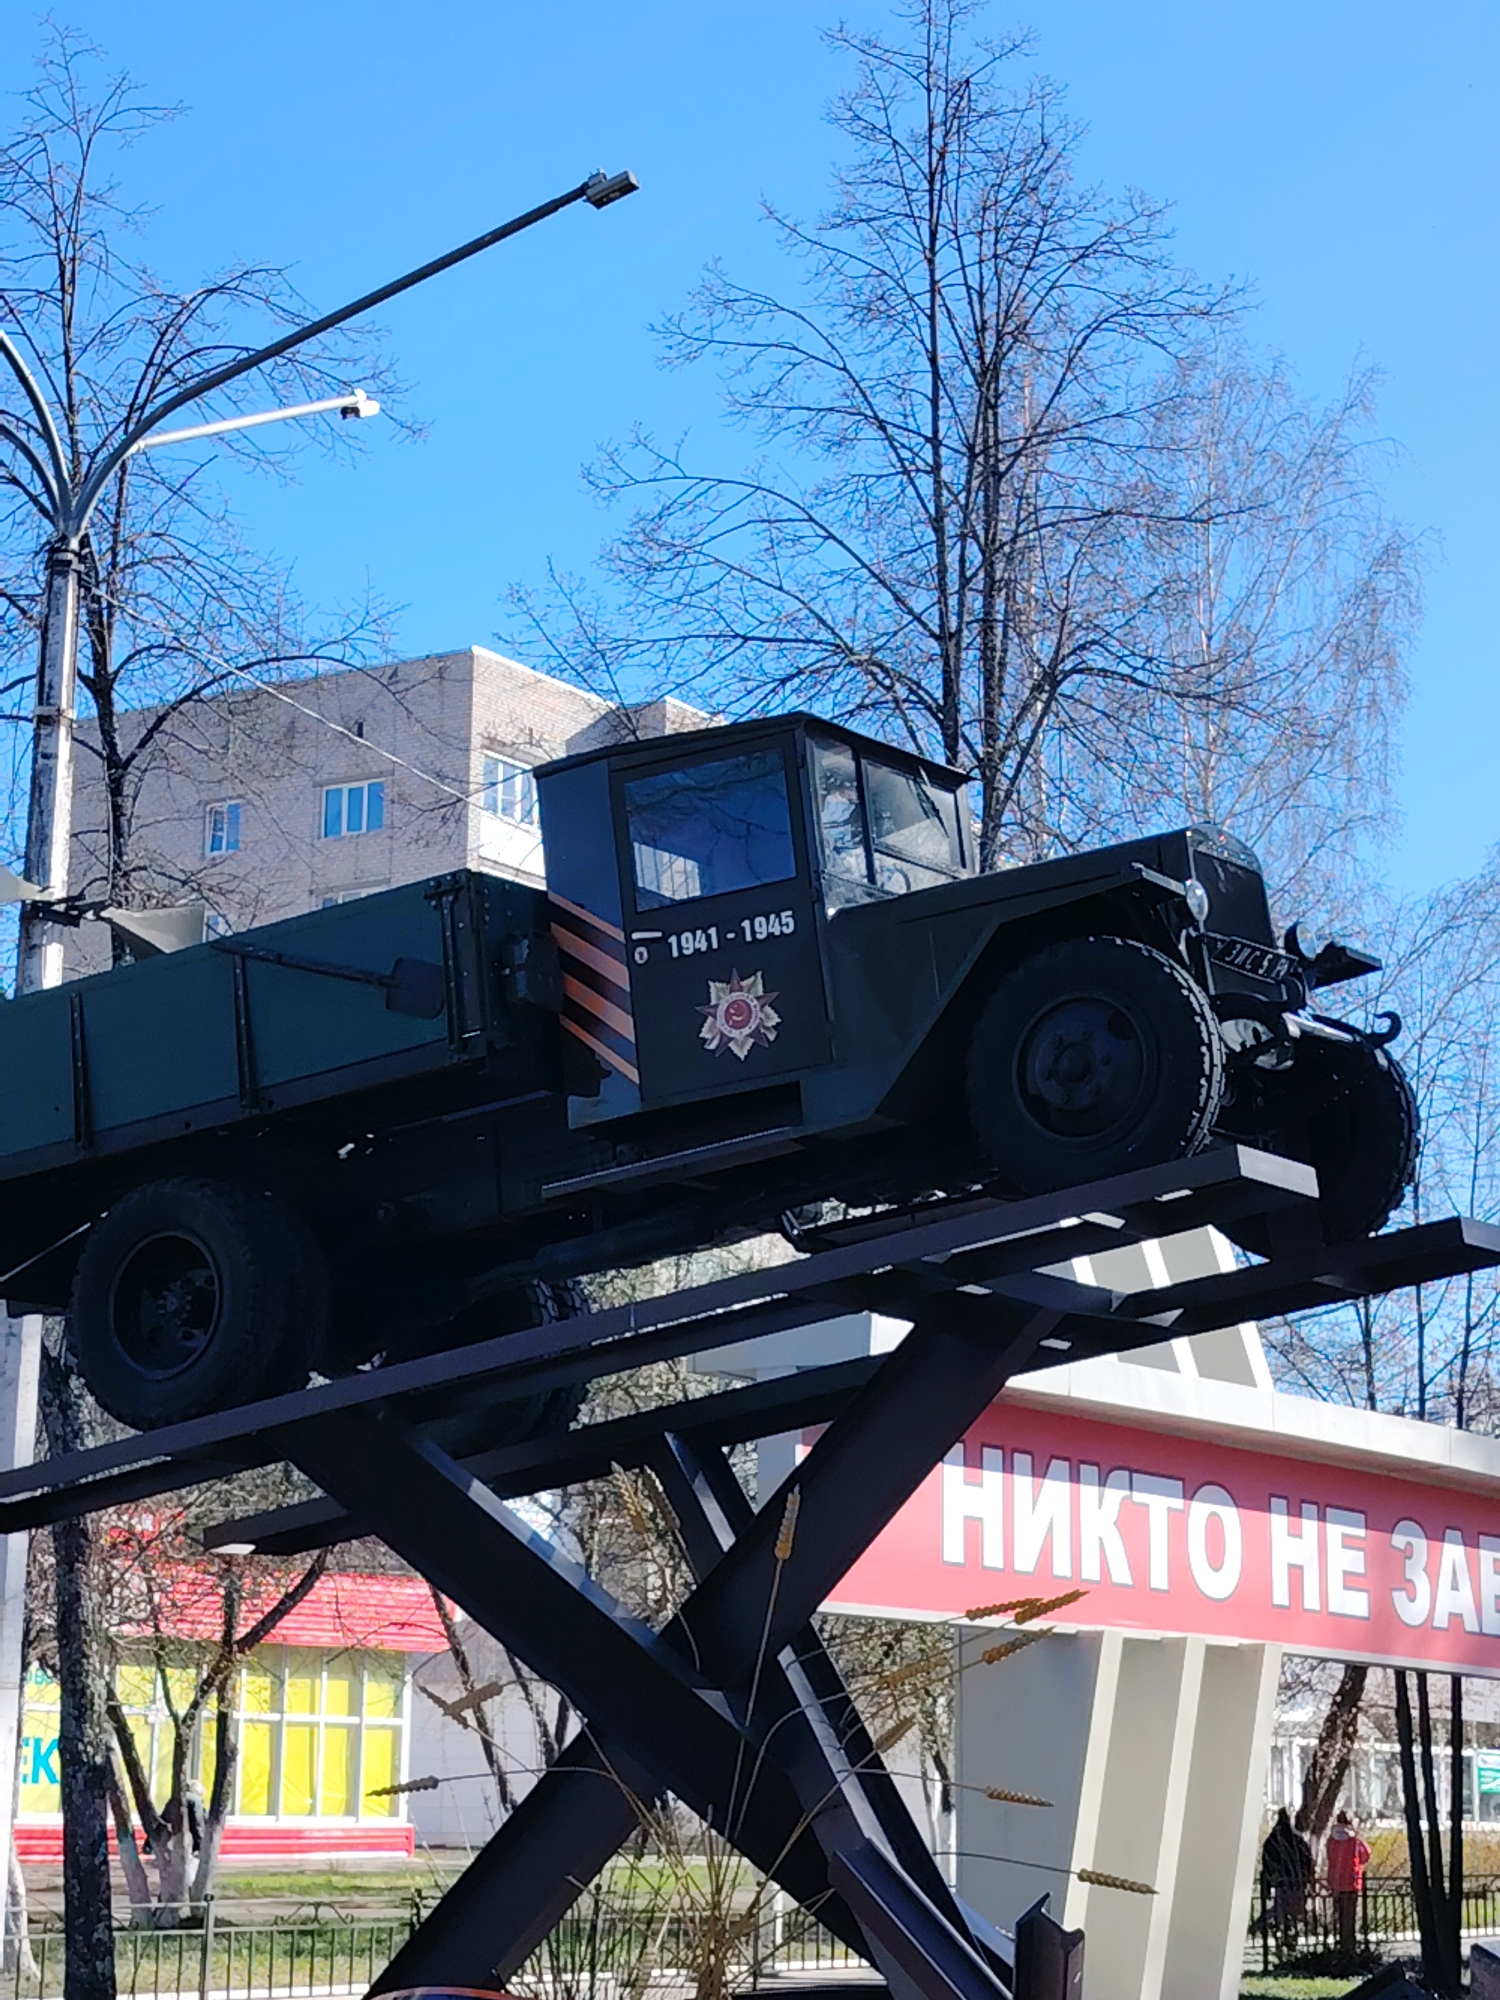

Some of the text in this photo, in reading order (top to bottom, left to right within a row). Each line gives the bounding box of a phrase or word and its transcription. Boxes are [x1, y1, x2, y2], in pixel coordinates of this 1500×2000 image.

[667, 926, 719, 959] 1941
[740, 910, 795, 942] 1945
[940, 1441, 1242, 1600] НИКТО
[1266, 1494, 1371, 1620] НЕ
